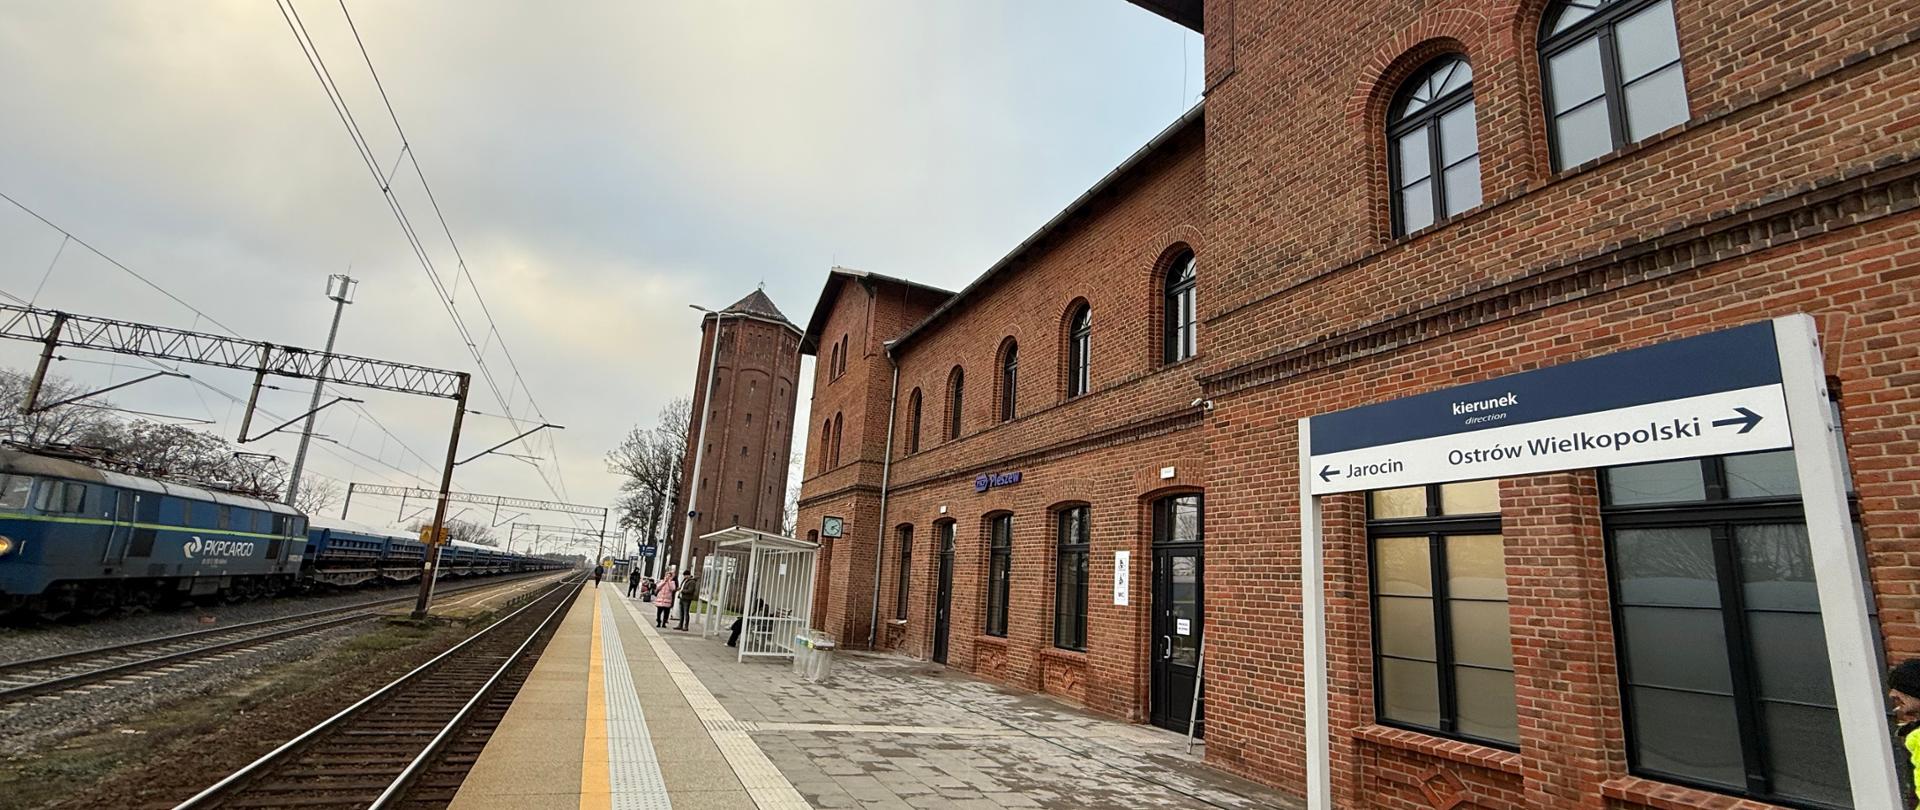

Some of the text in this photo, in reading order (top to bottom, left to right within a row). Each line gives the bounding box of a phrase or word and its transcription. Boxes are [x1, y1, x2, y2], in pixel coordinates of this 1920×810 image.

[1452, 392, 1518, 415] kierunek
[1465, 412, 1507, 425] direction
[1448, 416, 1702, 466] Ostrów Wielkopolski
[1346, 458, 1403, 479] Jarocin
[989, 471, 1020, 488] Pleszew
